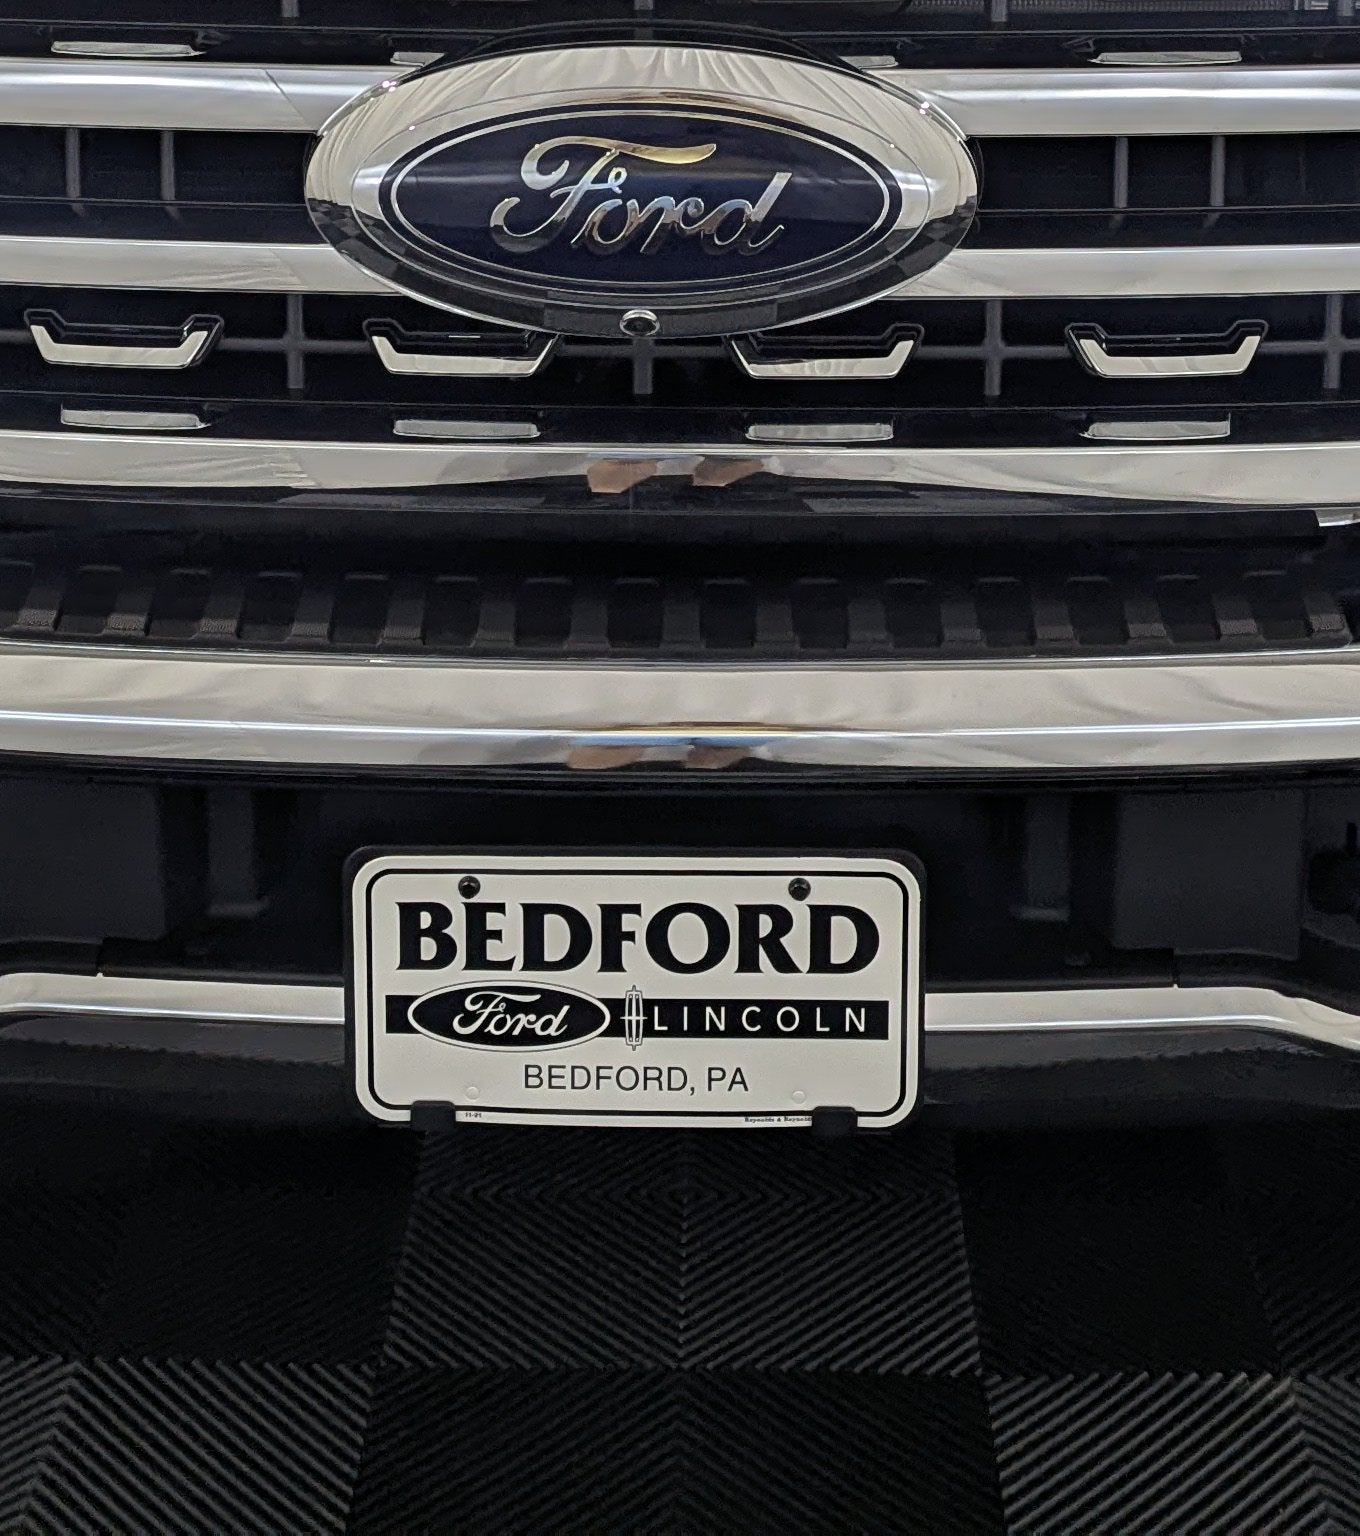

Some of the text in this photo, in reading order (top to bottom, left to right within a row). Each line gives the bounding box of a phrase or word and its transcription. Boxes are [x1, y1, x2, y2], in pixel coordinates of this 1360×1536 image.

[489, 134, 793, 255] Ford
[394, 900, 880, 975] BEDFORD
[452, 991, 571, 1038] Ford
[653, 1005, 867, 1034] LINCOLN
[524, 1064, 750, 1097] BEDFORD, PA
